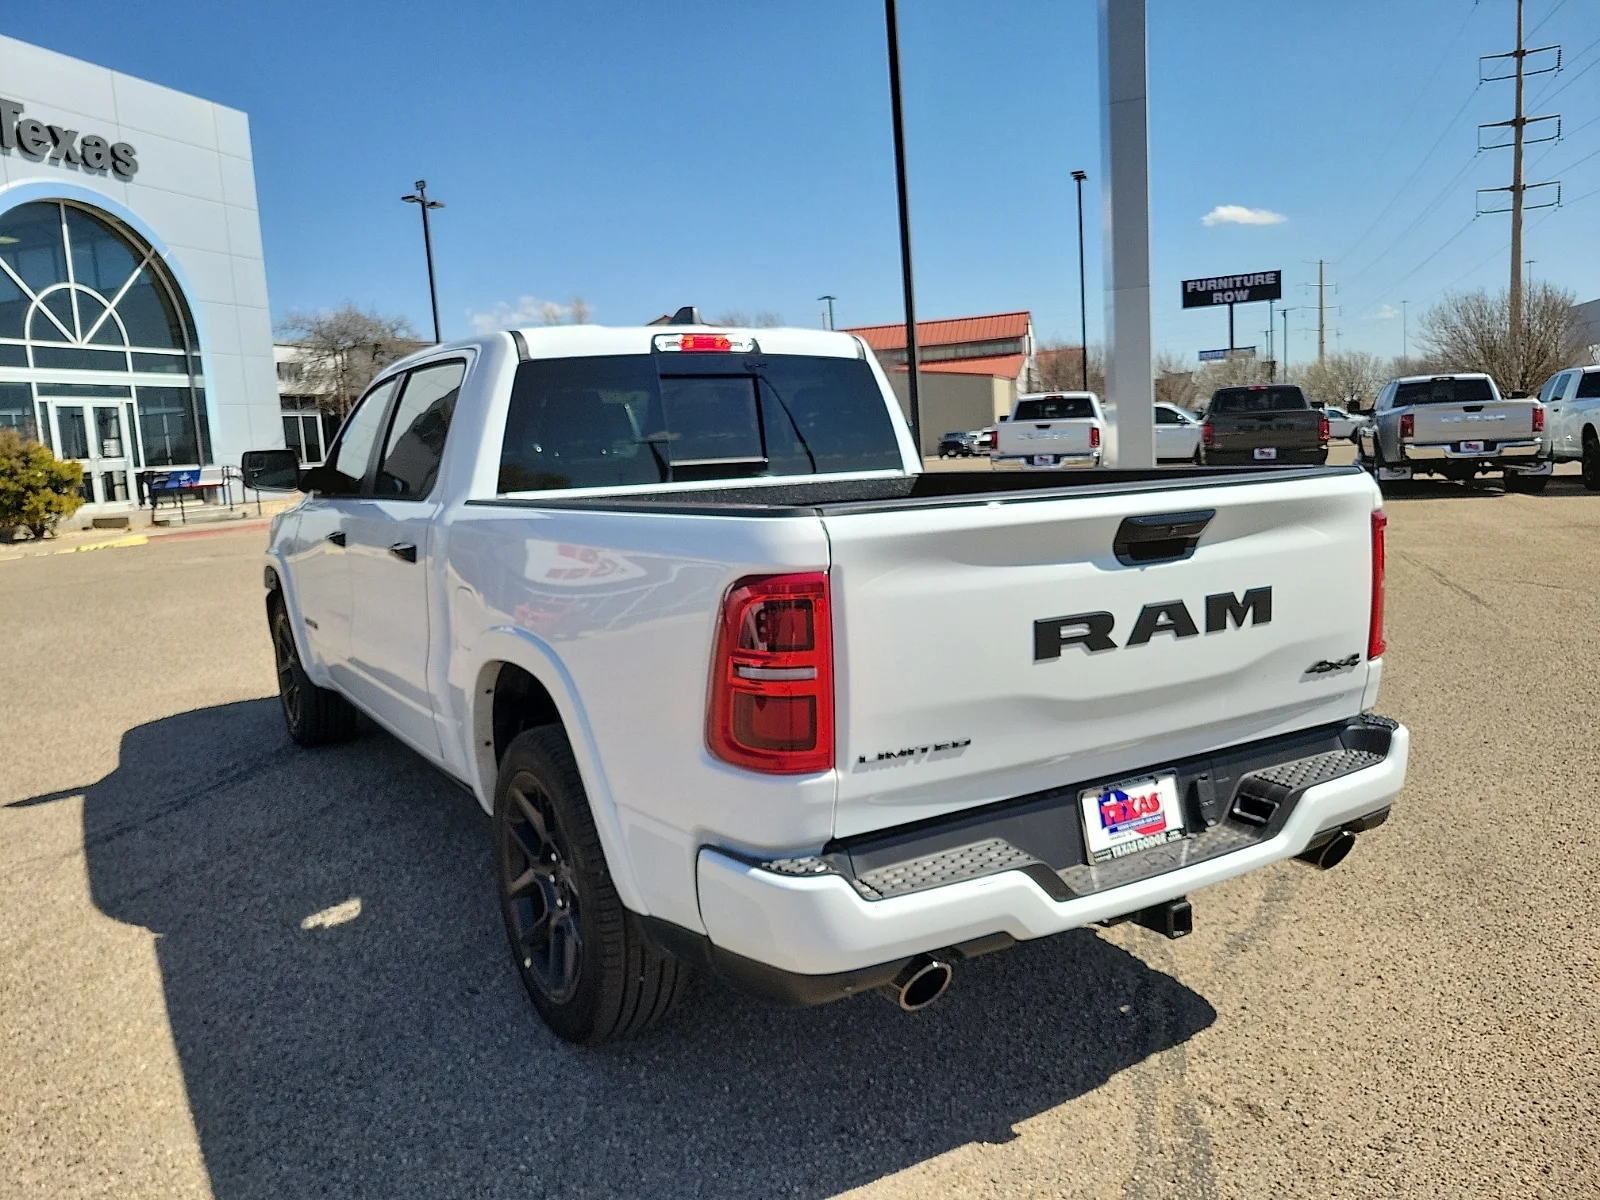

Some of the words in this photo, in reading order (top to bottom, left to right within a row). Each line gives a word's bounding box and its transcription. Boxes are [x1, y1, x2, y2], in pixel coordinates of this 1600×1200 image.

[0, 98, 139, 178] Texas
[1186, 272, 1277, 293] FURNITURE
[1212, 289, 1250, 304] ROW
[1033, 585, 1272, 661] RAM
[858, 739, 971, 763] LIMITED
[1101, 792, 1161, 826] TEXAS
